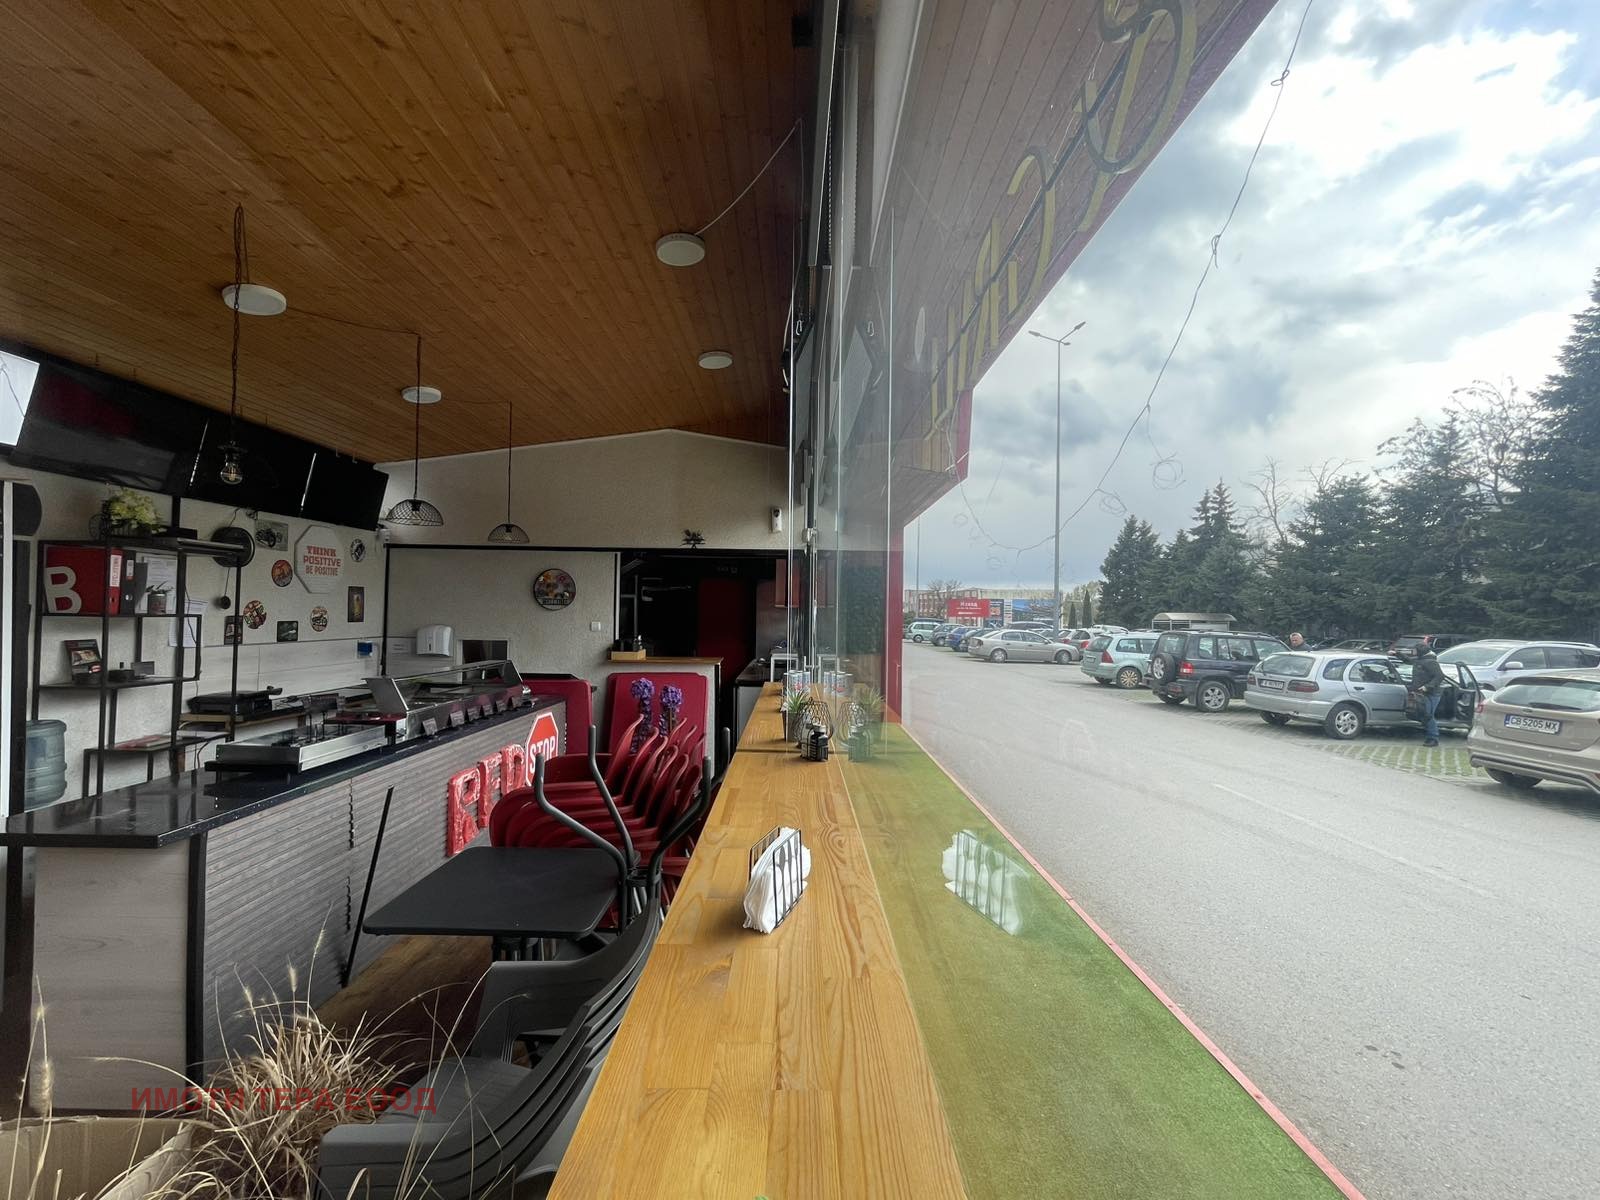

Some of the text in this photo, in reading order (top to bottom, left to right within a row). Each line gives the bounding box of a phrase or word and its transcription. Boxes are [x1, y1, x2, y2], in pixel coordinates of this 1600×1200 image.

[307, 546, 336, 557] THINK
[303, 555, 341, 567] POSITIVE
[305, 565, 338, 576] BE POSITIVE
[43, 566, 82, 614] B
[1511, 716, 1557, 730] CB 5205 MX
[529, 736, 556, 774] STOP
[447, 744, 526, 858] RED
